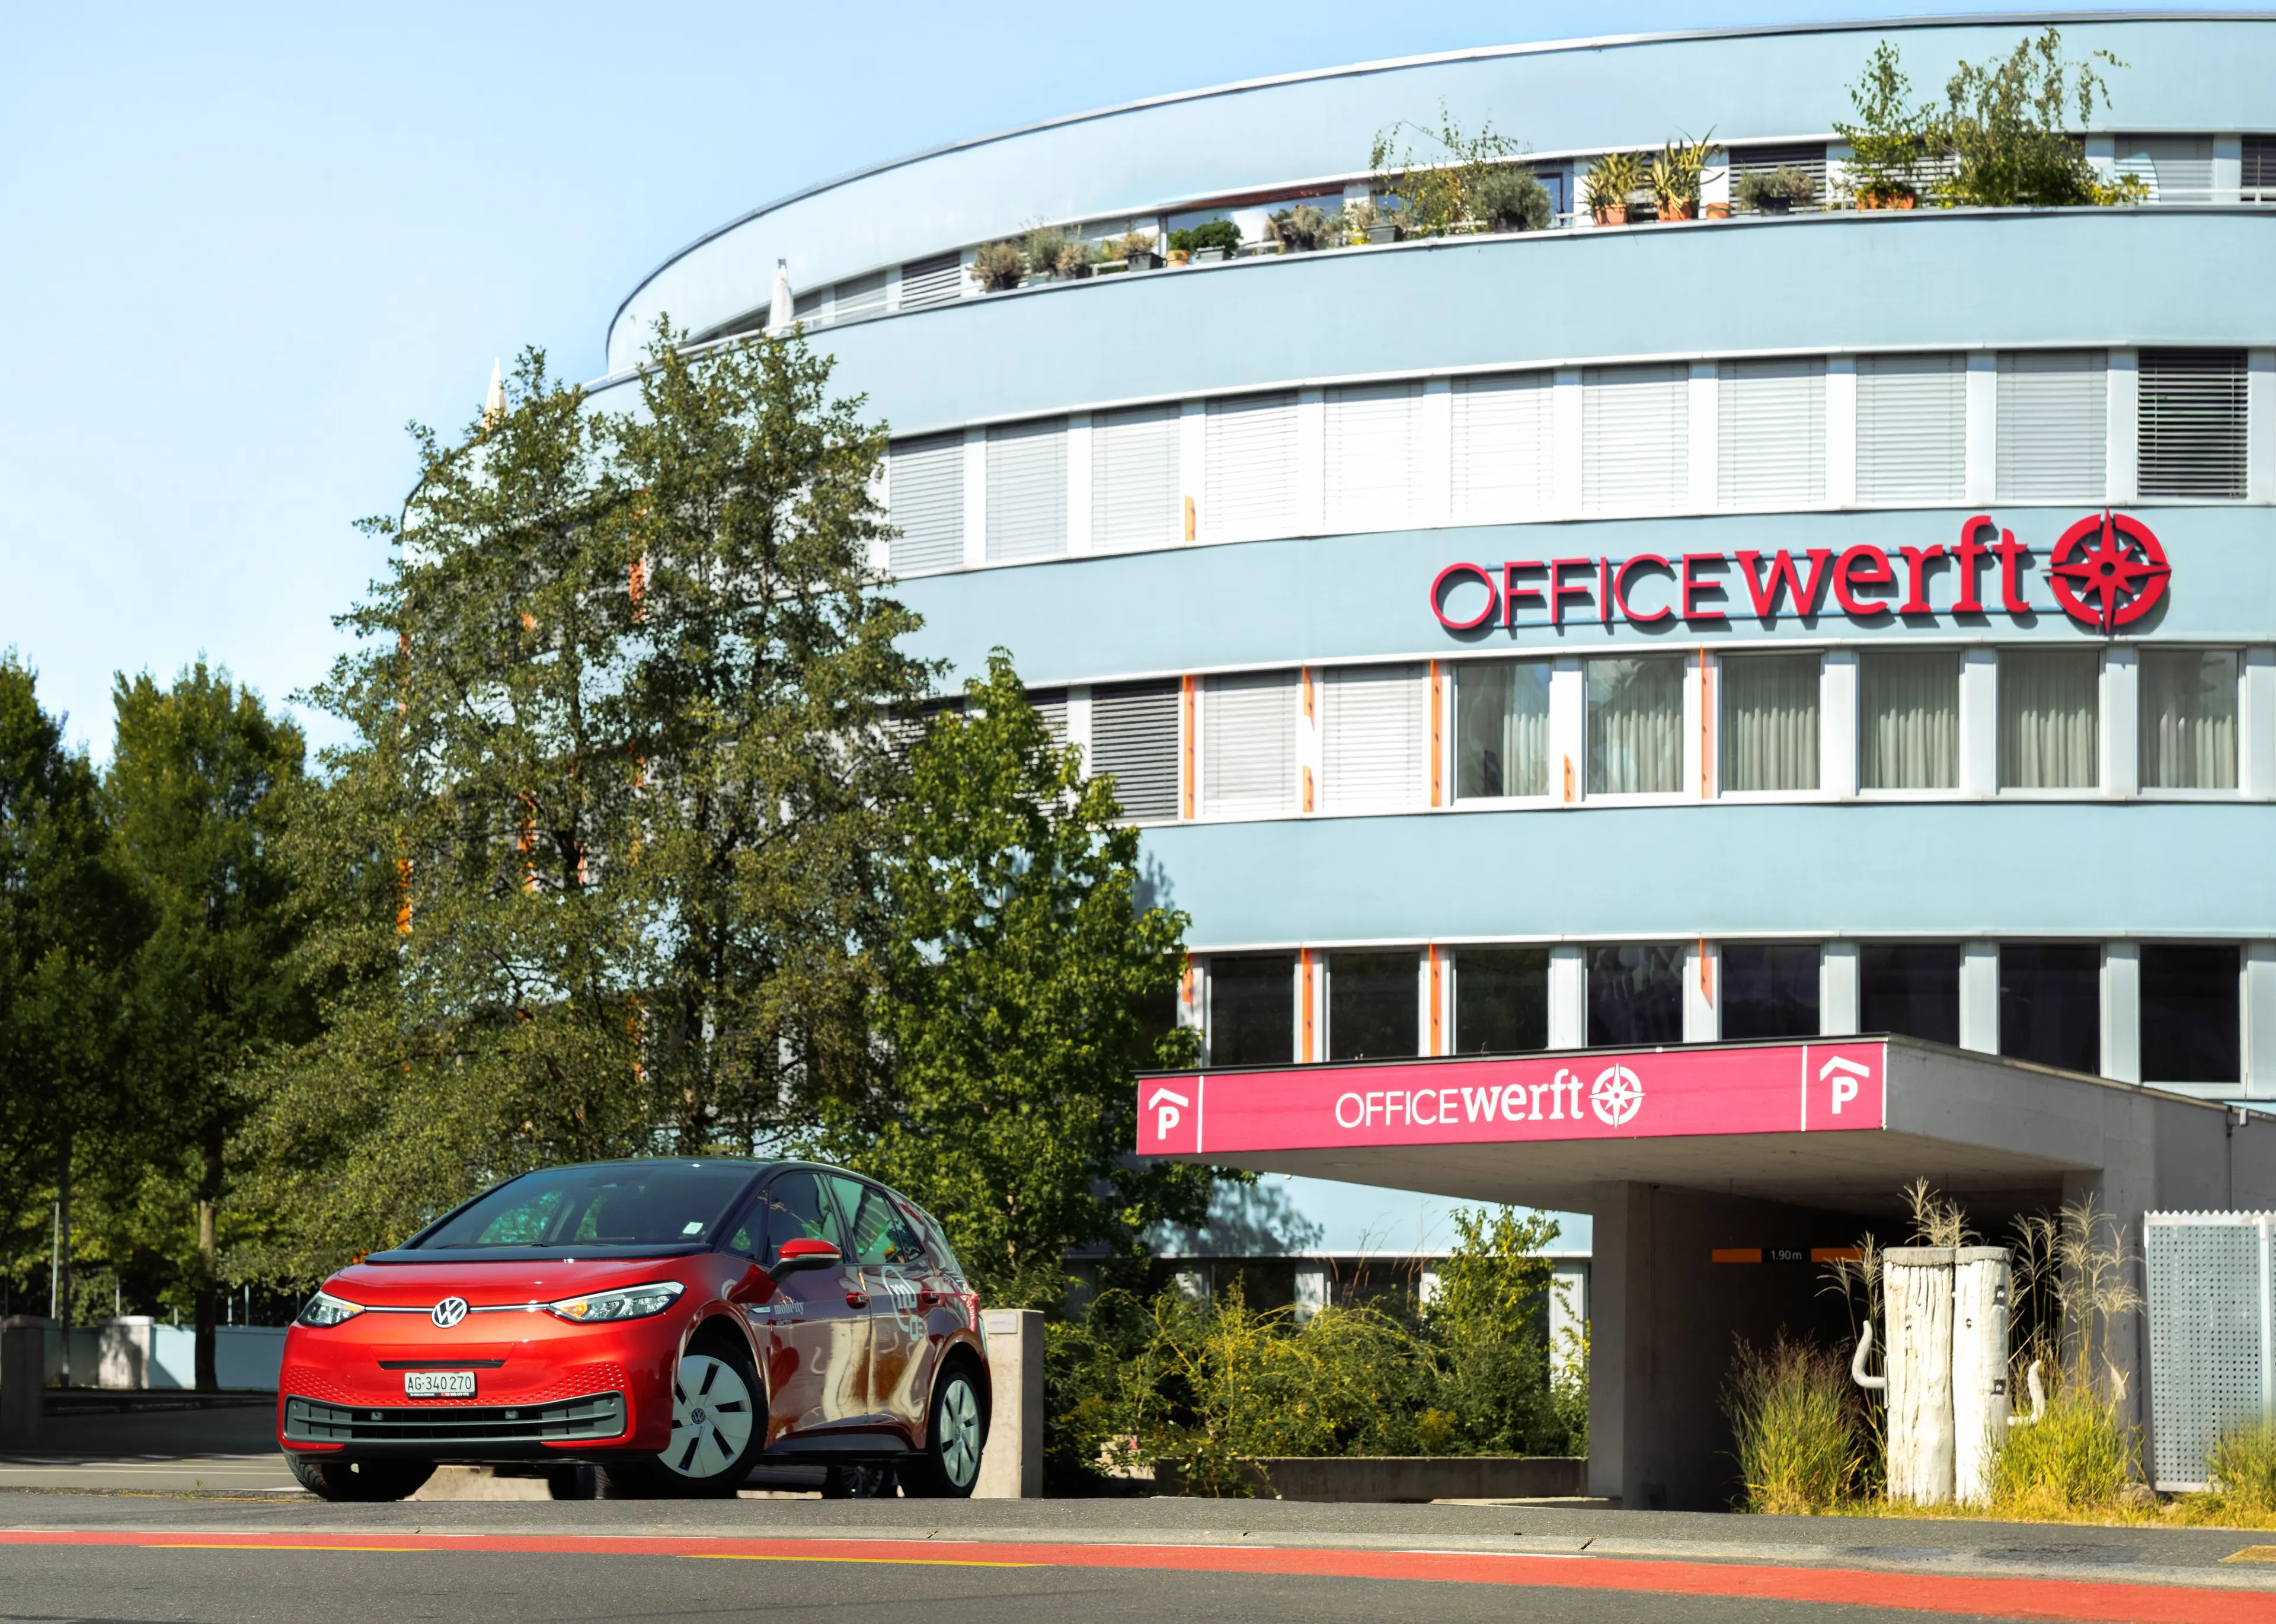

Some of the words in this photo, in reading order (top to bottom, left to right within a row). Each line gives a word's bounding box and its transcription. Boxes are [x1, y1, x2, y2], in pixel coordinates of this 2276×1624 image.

[1335, 1069, 1584, 1129] OFFICEwerft
[1831, 1076, 1858, 1114] P
[1158, 1106, 1179, 1140] P
[1771, 1250, 1791, 1260] 1.90
[1792, 1252, 1802, 1260] m
